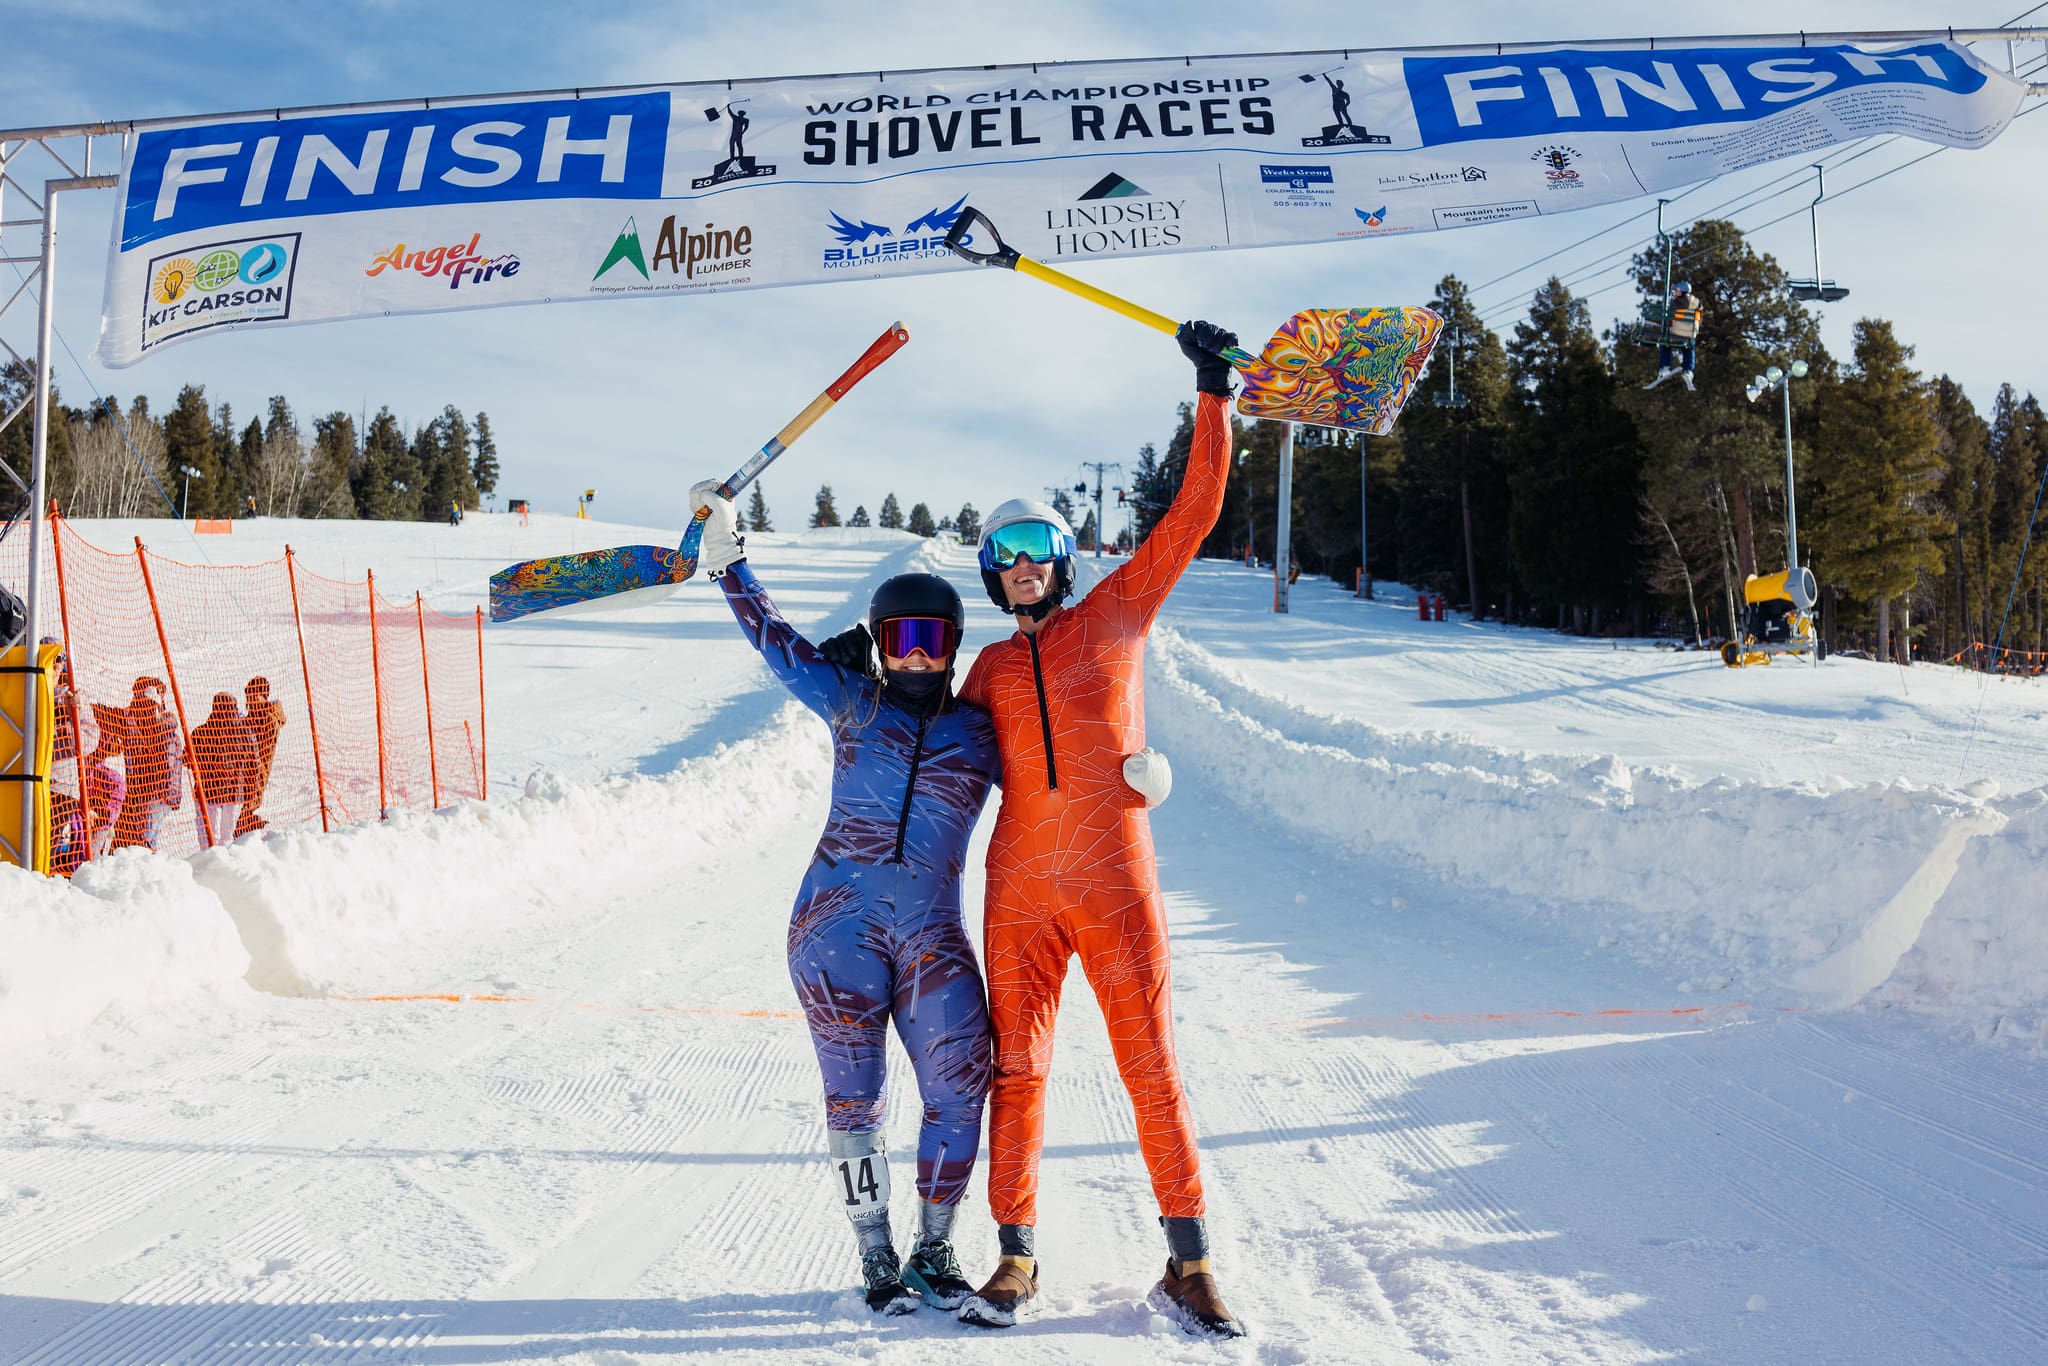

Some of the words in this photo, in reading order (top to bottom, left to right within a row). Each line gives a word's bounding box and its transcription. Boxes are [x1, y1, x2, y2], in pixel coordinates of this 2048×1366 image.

[805, 94, 952, 117] WORLD
[966, 78, 1271, 105] CHAMPIONSHIP
[803, 107, 1042, 167] SHOVEL
[1072, 97, 1276, 143] RACES
[153, 114, 633, 222] FINISH
[756, 167, 773, 176] 25
[1296, 169, 1329, 177] Group
[1408, 171, 1459, 185] Sutton
[695, 179, 712, 188] 20
[1046, 200, 1186, 230] LINDSEY
[1443, 208, 1493, 219] Mountain
[1496, 204, 1528, 213] Home
[1464, 212, 1511, 222] Services
[652, 214, 752, 280] Alpine
[1056, 224, 1181, 255] HOMES
[364, 232, 482, 277] Angel
[696, 258, 752, 275] LUMBER
[823, 251, 909, 269] MOUNTAIN
[443, 255, 520, 290] Fire
[590, 285, 626, 294] Employee
[627, 284, 653, 292] Owned
[655, 283, 670, 291] and
[671, 281, 708, 291] Operated
[709, 279, 730, 288] since
[148, 304, 181, 329] KIT
[183, 286, 283, 316] CARSON
[838, 1157, 879, 1206] 14
[853, 1209, 876, 1221] ANGEL
